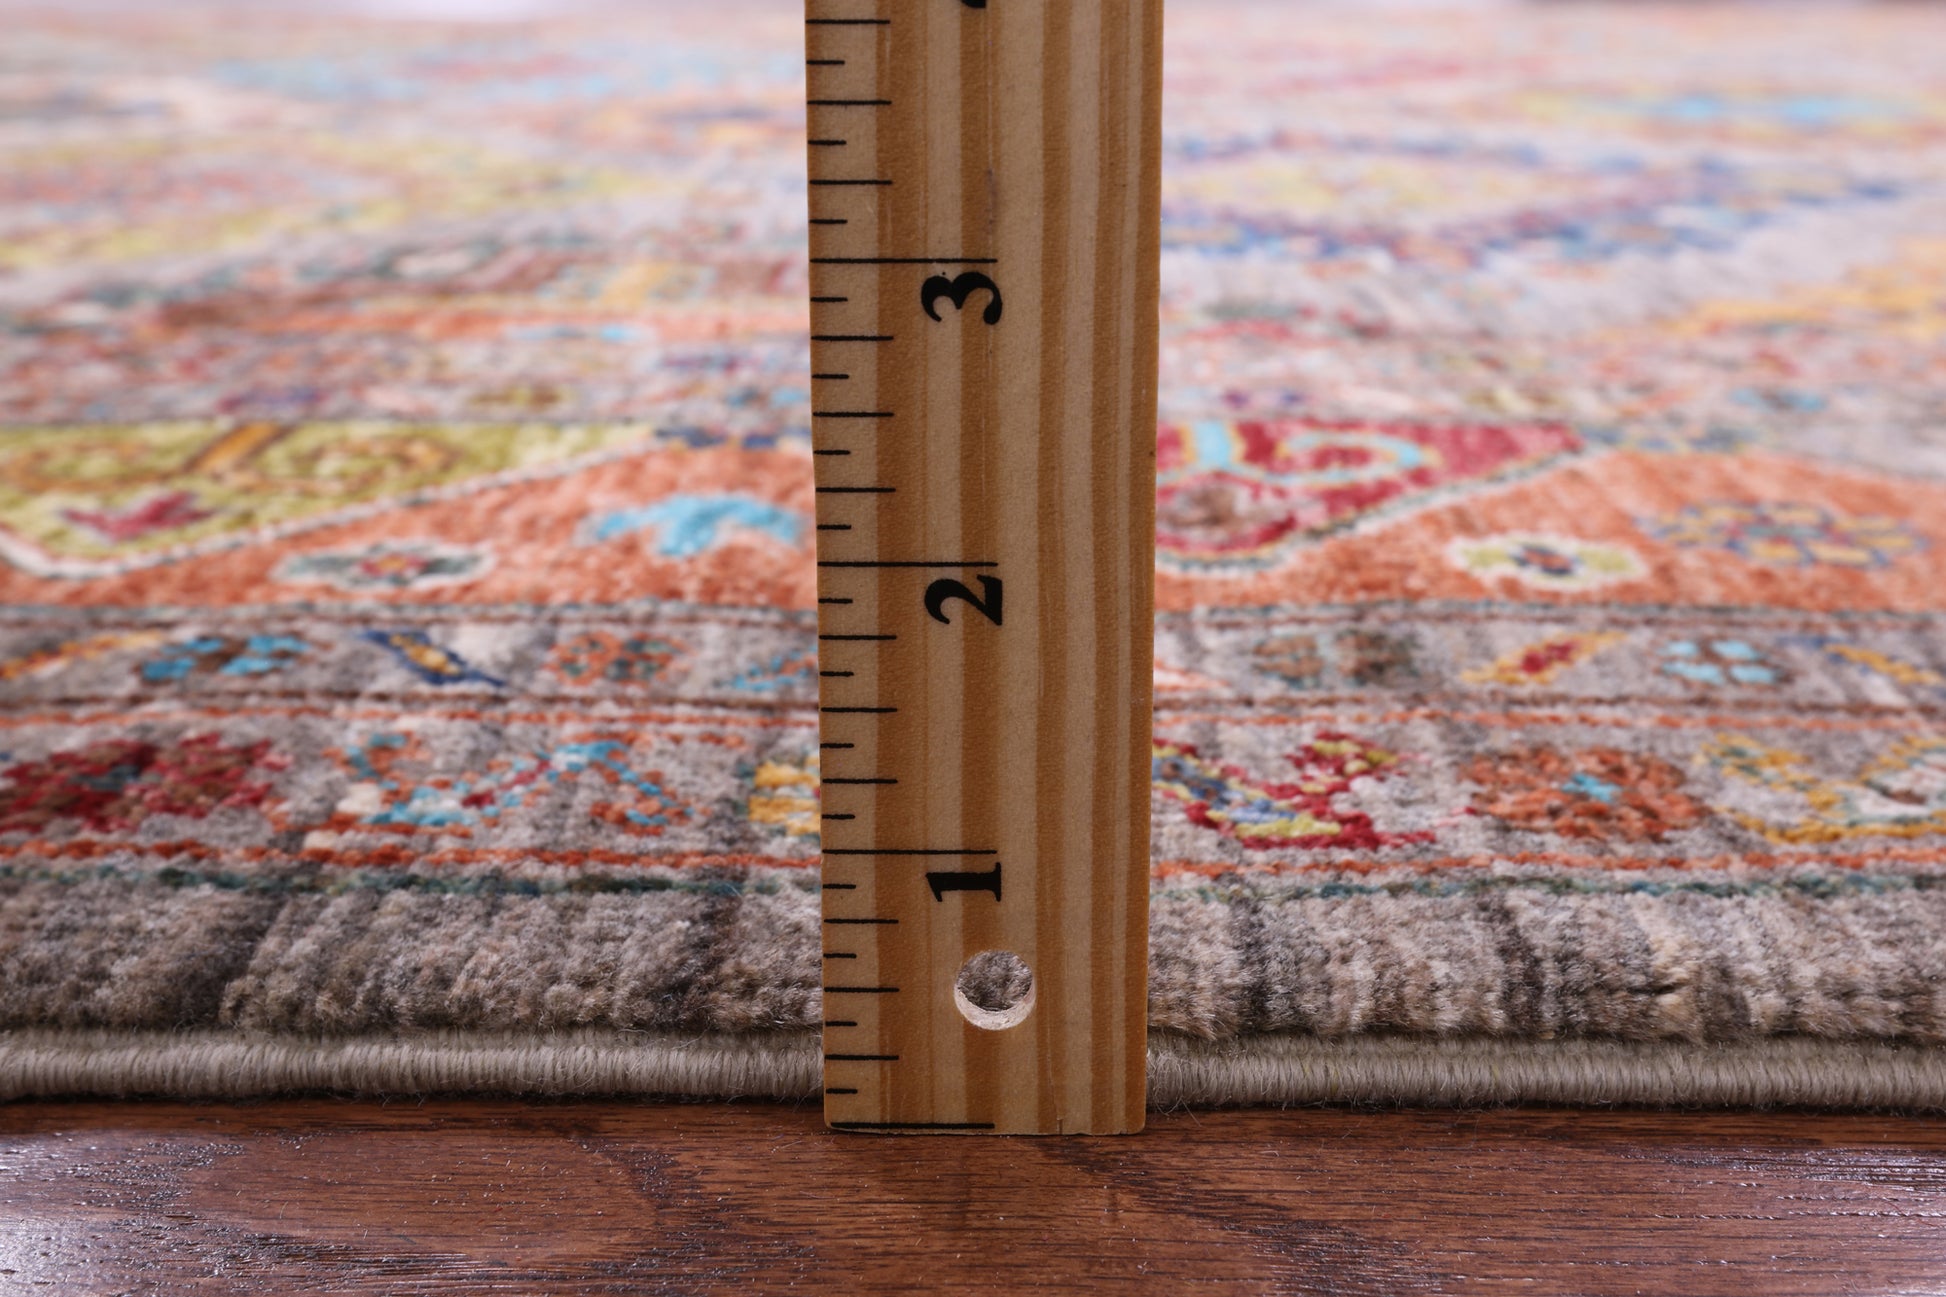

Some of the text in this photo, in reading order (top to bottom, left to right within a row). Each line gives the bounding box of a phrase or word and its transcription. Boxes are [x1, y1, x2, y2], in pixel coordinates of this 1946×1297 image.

[921, 271, 1003, 325] 3
[924, 574, 1003, 626] 2
[925, 862, 1002, 902] 1
